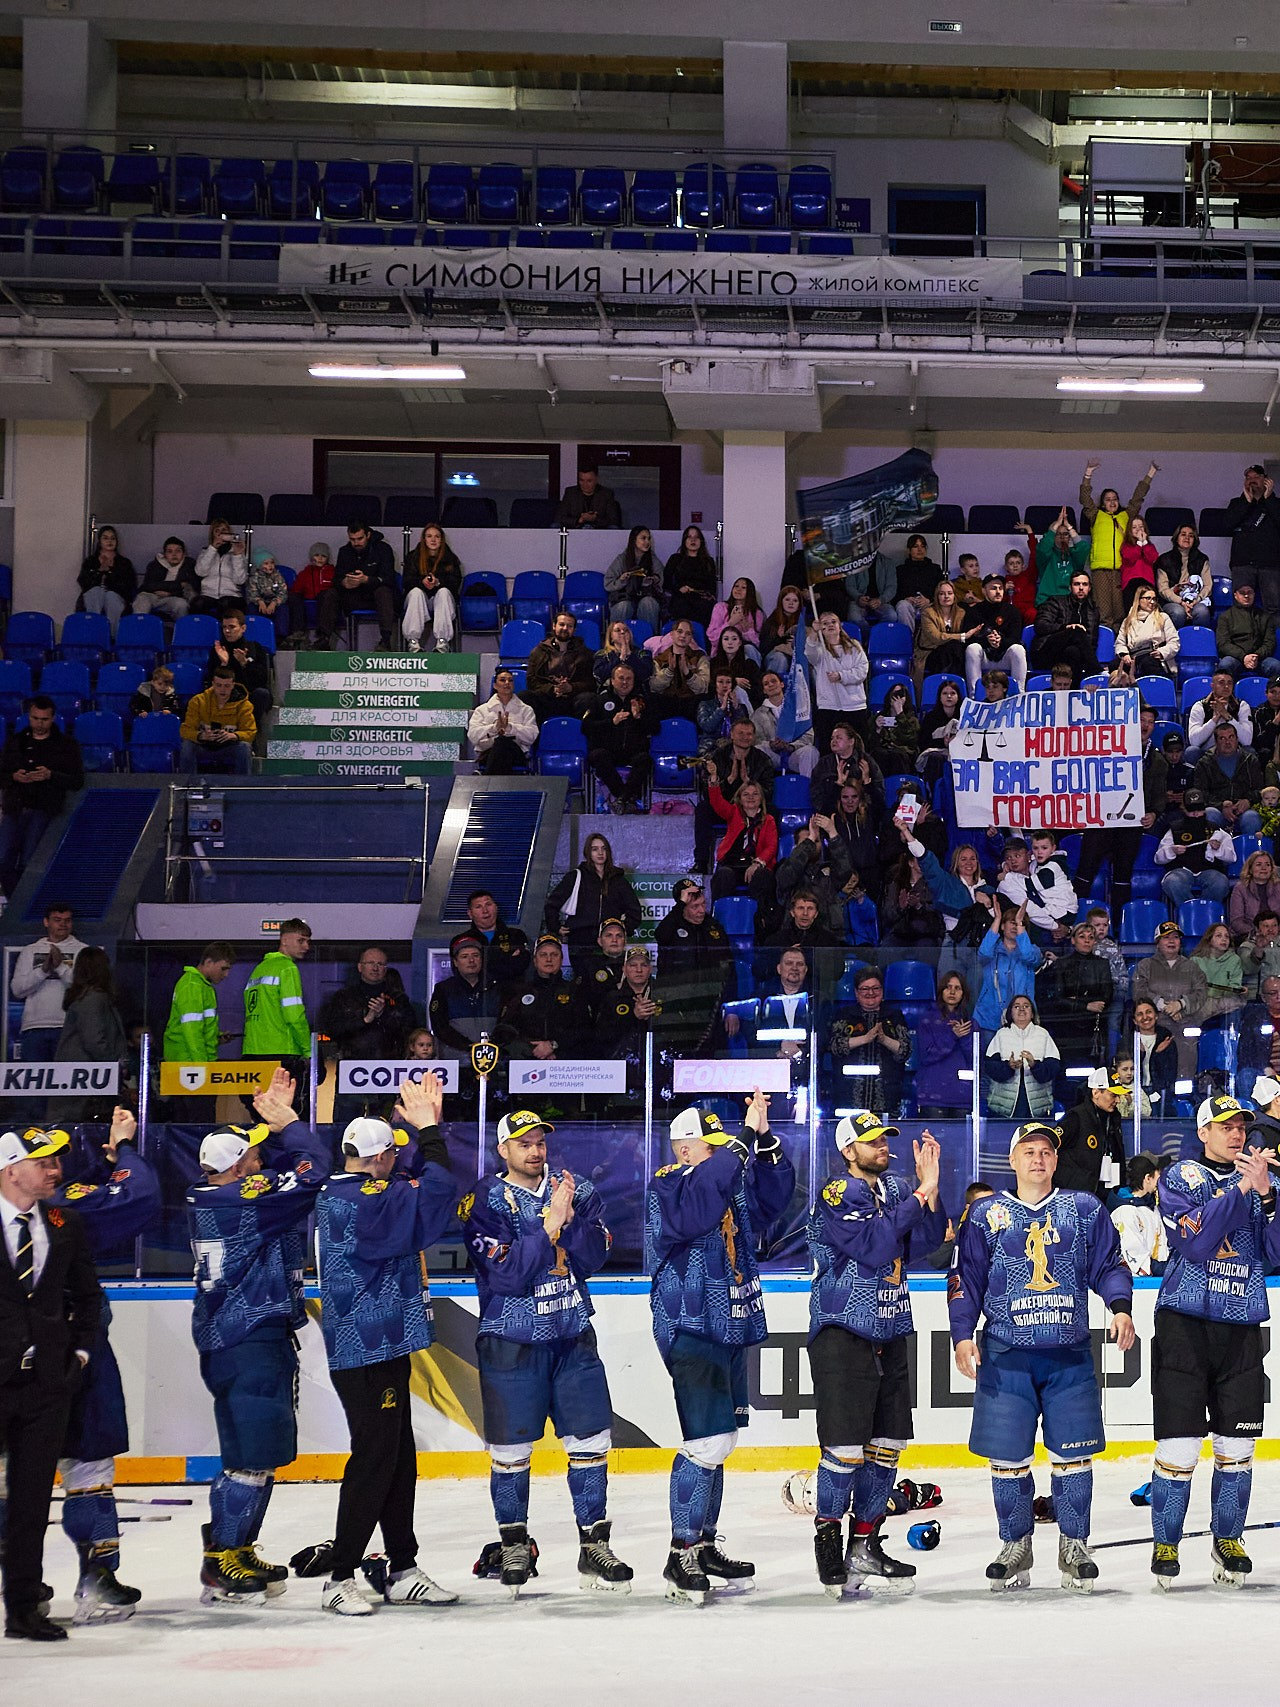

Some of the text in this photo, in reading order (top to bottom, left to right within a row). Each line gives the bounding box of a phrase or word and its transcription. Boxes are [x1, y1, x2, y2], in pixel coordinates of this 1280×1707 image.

[385, 262, 980, 296] СИМФОНИЯ НИЖНЕГО ЖИЛОЙ КОМПЛЕКС
[366, 657, 428, 670] SYNERGETIC
[343, 677, 429, 688] ДЛЯ ЧИСТОТЫ
[357, 695, 420, 707] SYNERGETIC
[331, 712, 418, 722] ДЛЯ КРАСОТЫ
[959, 692, 1056, 729] КОМАНДА
[348, 730, 413, 742] SYNERGETIC
[1025, 725, 1127, 758] МОЛОДЕЦ
[316, 746, 413, 757] ДЛЯ ЗДОРОВЬЯ
[952, 755, 1141, 794] ЗА ВАС БОЛЕЕТ
[993, 793, 1104, 828] ГОРОДЕЦ
[3, 1068, 112, 1090] KHL.RU
[187, 1072, 262, 1084] Т БАНК
[676, 1065, 784, 1087] FONBET
[1231, 1281, 1245, 1297] СУД
[1013, 1311, 1060, 1327] ОБЛАСТНОЙ
[1061, 1440, 1098, 1449] EASTON
